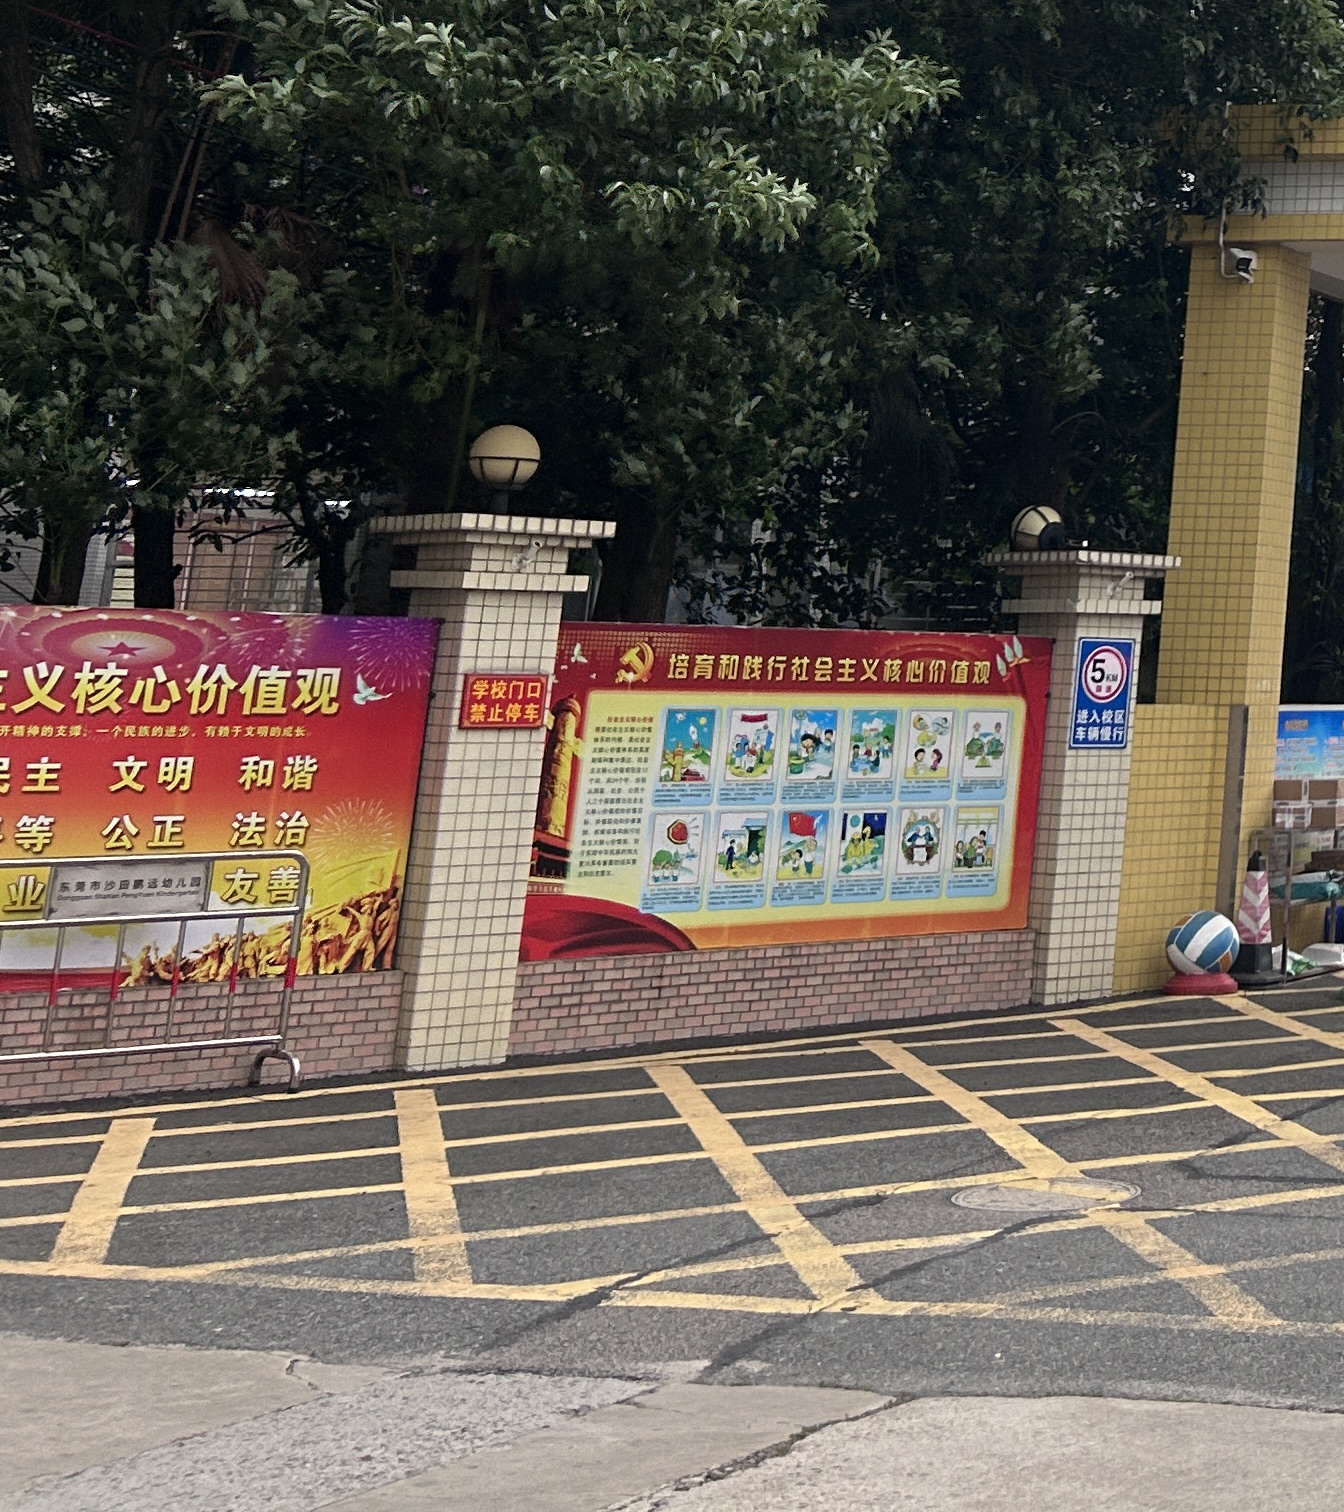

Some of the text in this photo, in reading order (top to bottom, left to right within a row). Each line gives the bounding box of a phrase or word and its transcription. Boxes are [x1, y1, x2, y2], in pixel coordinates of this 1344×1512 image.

[667, 653, 991, 684] 培育和践行社会主义核心价值观
[0, 661, 342, 715] 义核心价值观
[472, 680, 541, 700] 学校门口
[470, 703, 540, 723] 禁止停车
[1076, 709, 1125, 724] 进入校区
[1075, 726, 1124, 741] 车辆慢行
[0, 754, 319, 794] 主 文明 和谐
[101, 813, 186, 850] 公正
[229, 809, 310, 848] 法治
[3, 866, 300, 912] 业 友善
